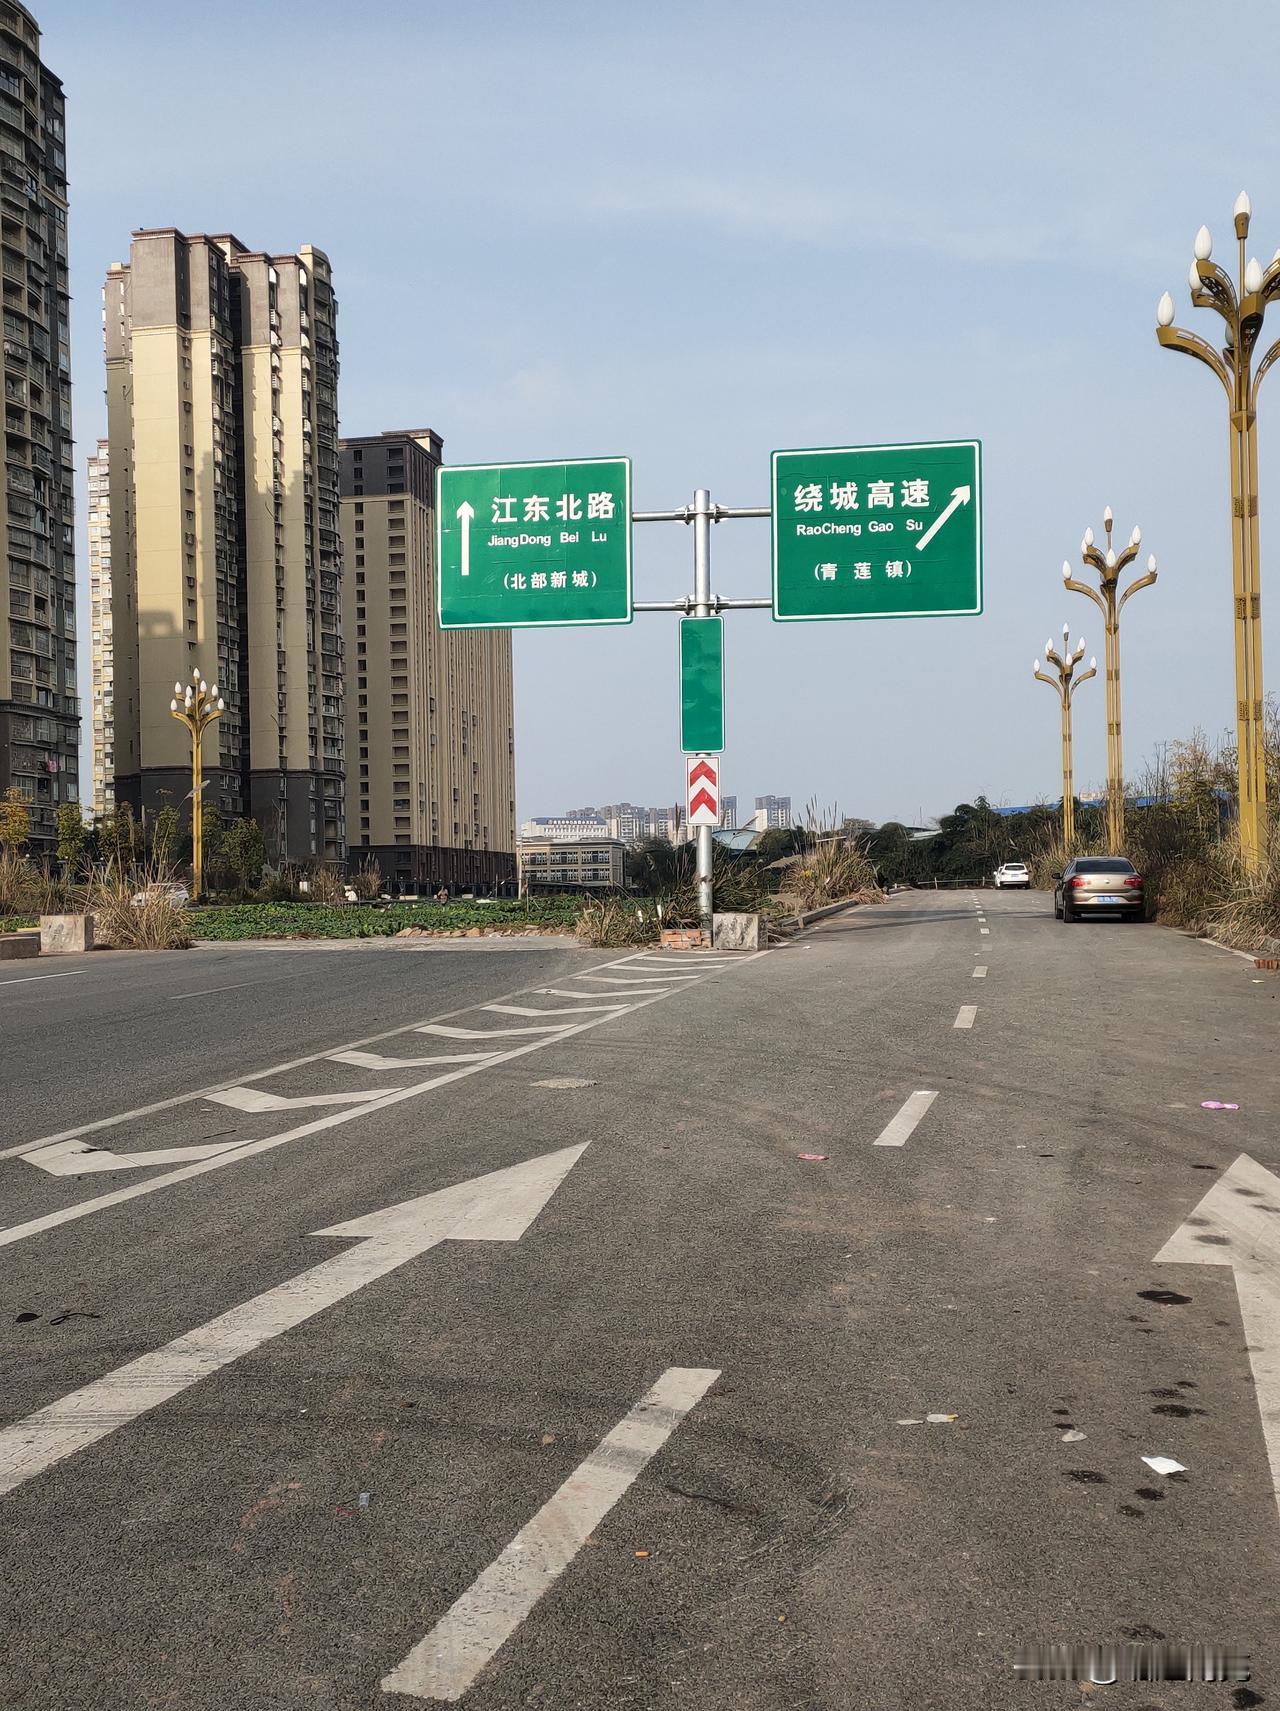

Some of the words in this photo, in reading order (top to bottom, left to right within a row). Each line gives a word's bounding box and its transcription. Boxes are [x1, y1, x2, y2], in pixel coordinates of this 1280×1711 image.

[793, 478, 930, 512] 绕城高速
[491, 491, 615, 524] 江东北路
[796, 522, 862, 536] RaoCheng
[868, 520, 894, 533] Gao
[905, 519, 923, 531] Su
[487, 533, 551, 548] JiangDong
[559, 531, 579, 543] Bei
[591, 531, 607, 543] Lu
[503, 570, 597, 590] (北部新城)
